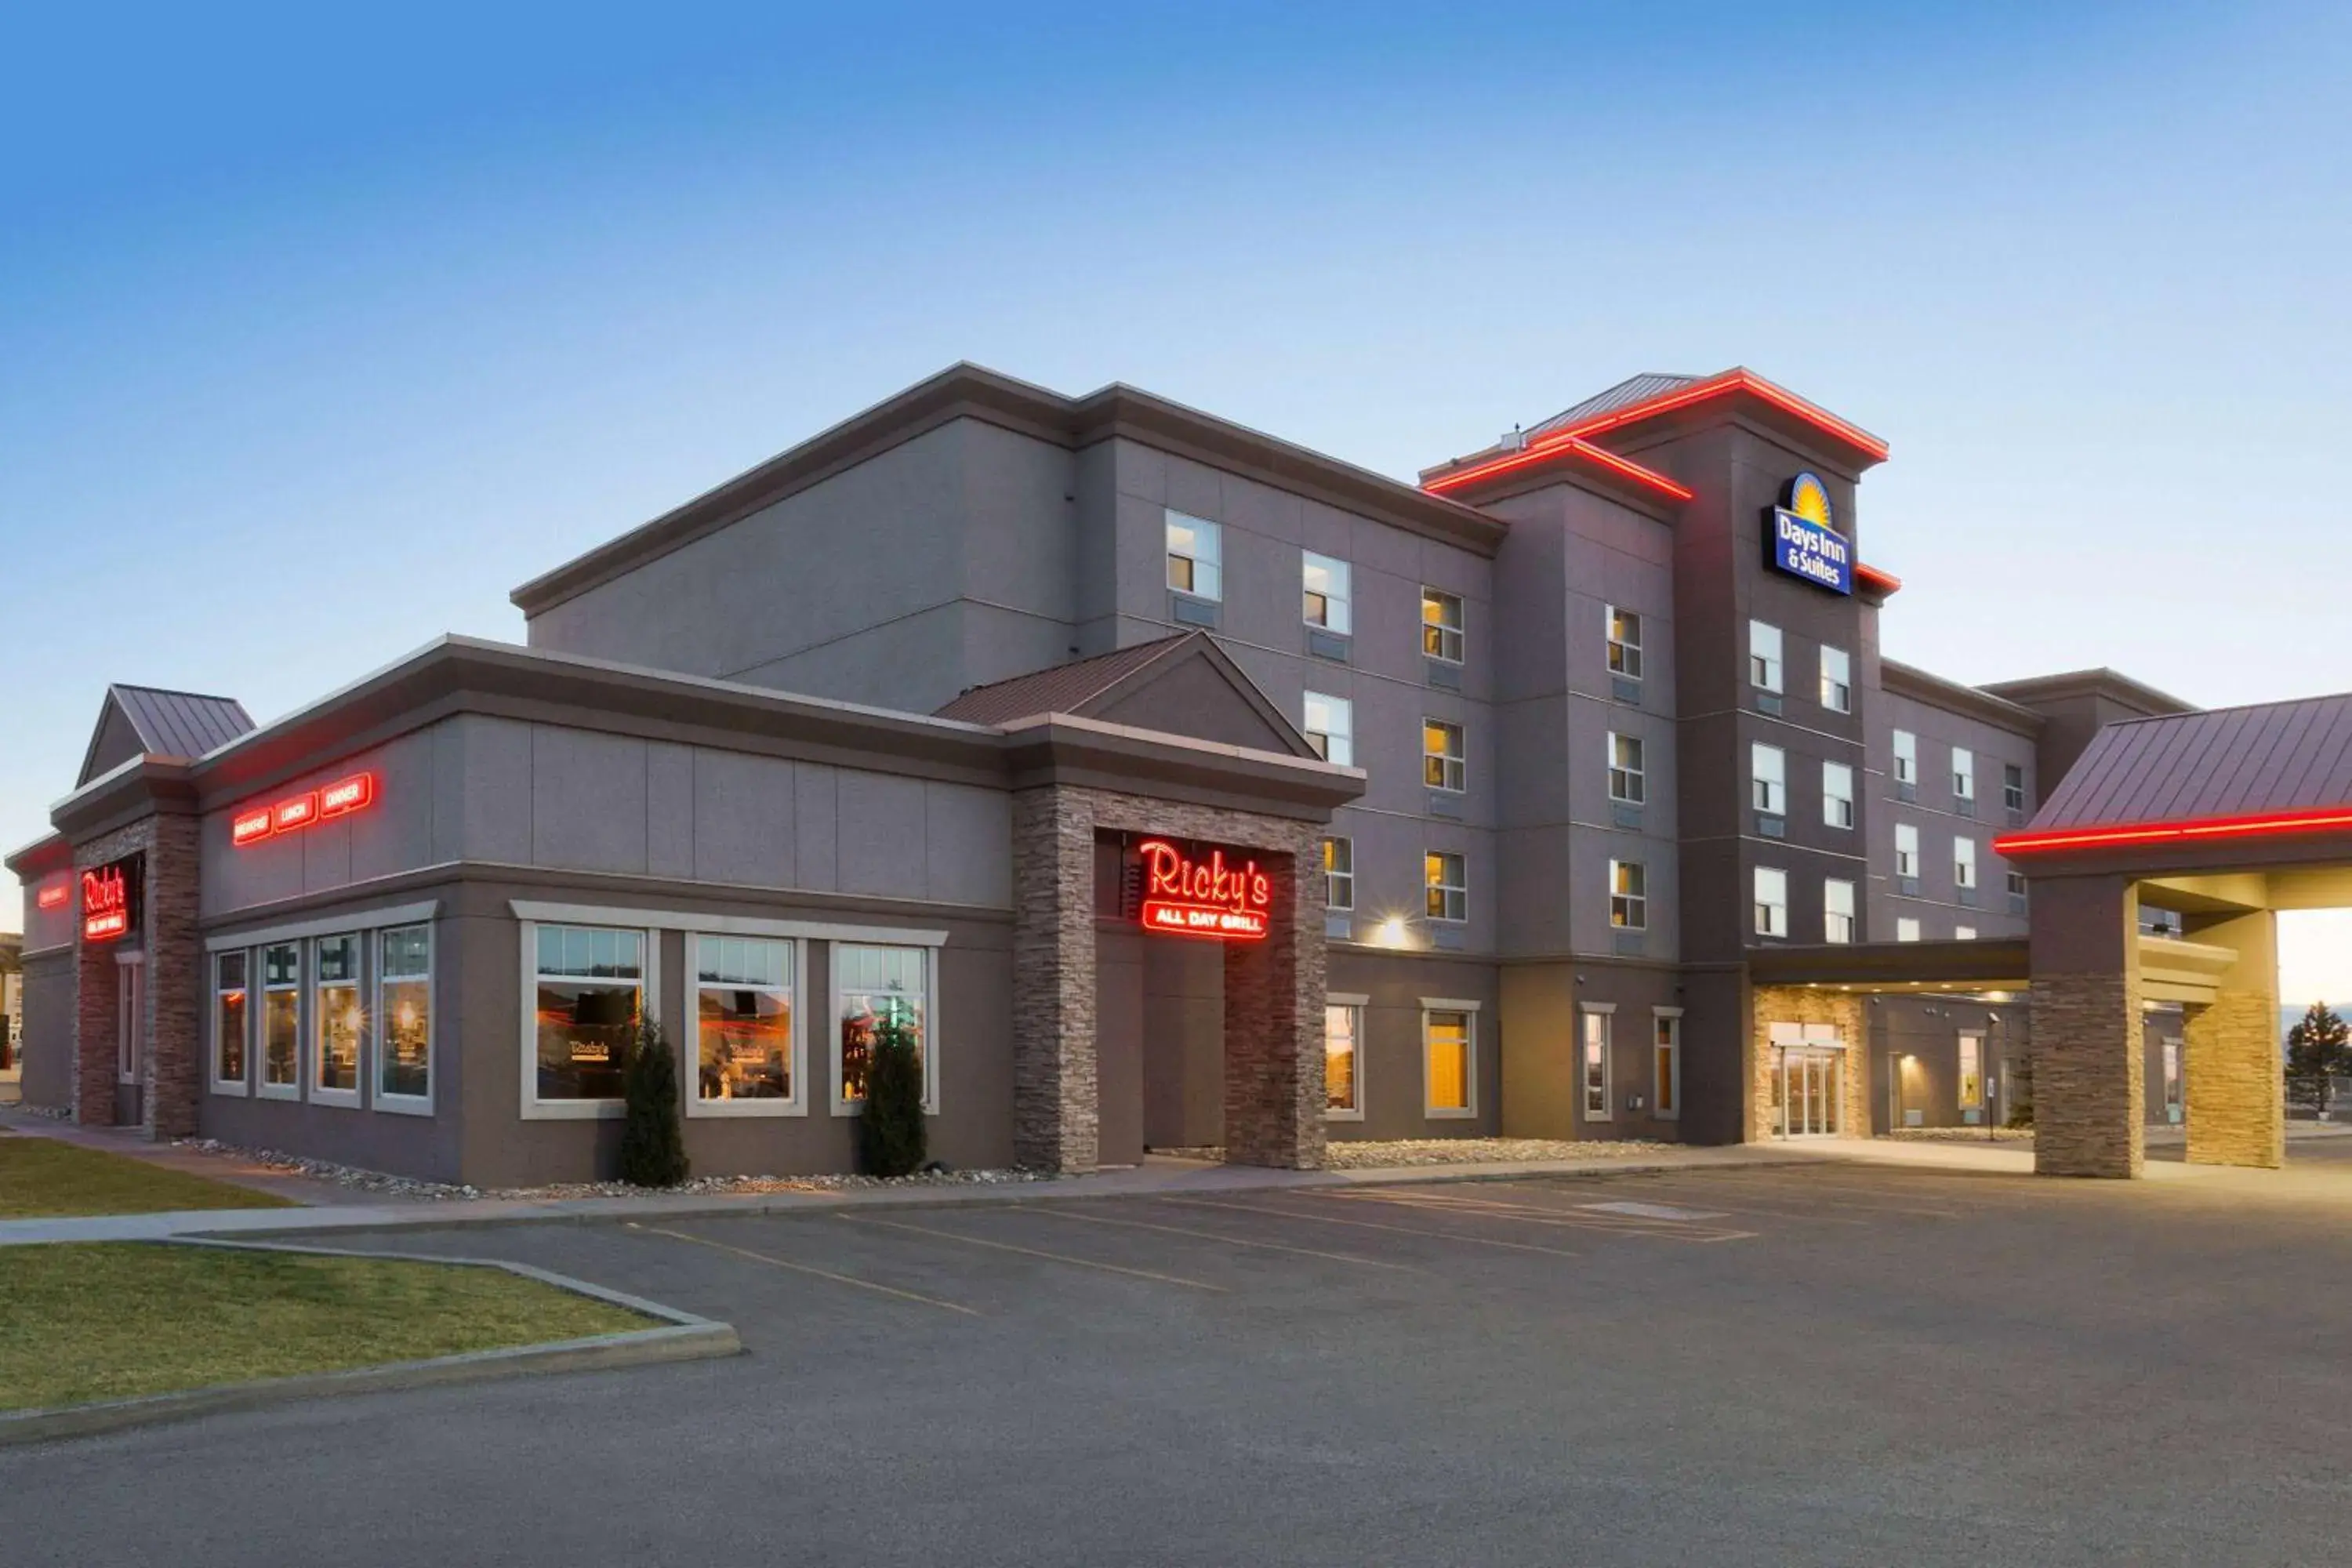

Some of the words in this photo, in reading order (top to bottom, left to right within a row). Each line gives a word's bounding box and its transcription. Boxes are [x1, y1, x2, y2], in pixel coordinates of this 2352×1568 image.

[1780, 514, 1819, 552] Days
[1820, 532, 1846, 564] Inn
[1788, 548, 1798, 568] &
[1800, 551, 1840, 584] Suites
[281, 803, 307, 822] LUNCH
[325, 782, 359, 808] DINNER
[1141, 841, 1268, 915] Ricky's
[1156, 909, 1185, 925] ALL
[1189, 911, 1218, 927] DAY
[1220, 914, 1263, 931] GRILL
